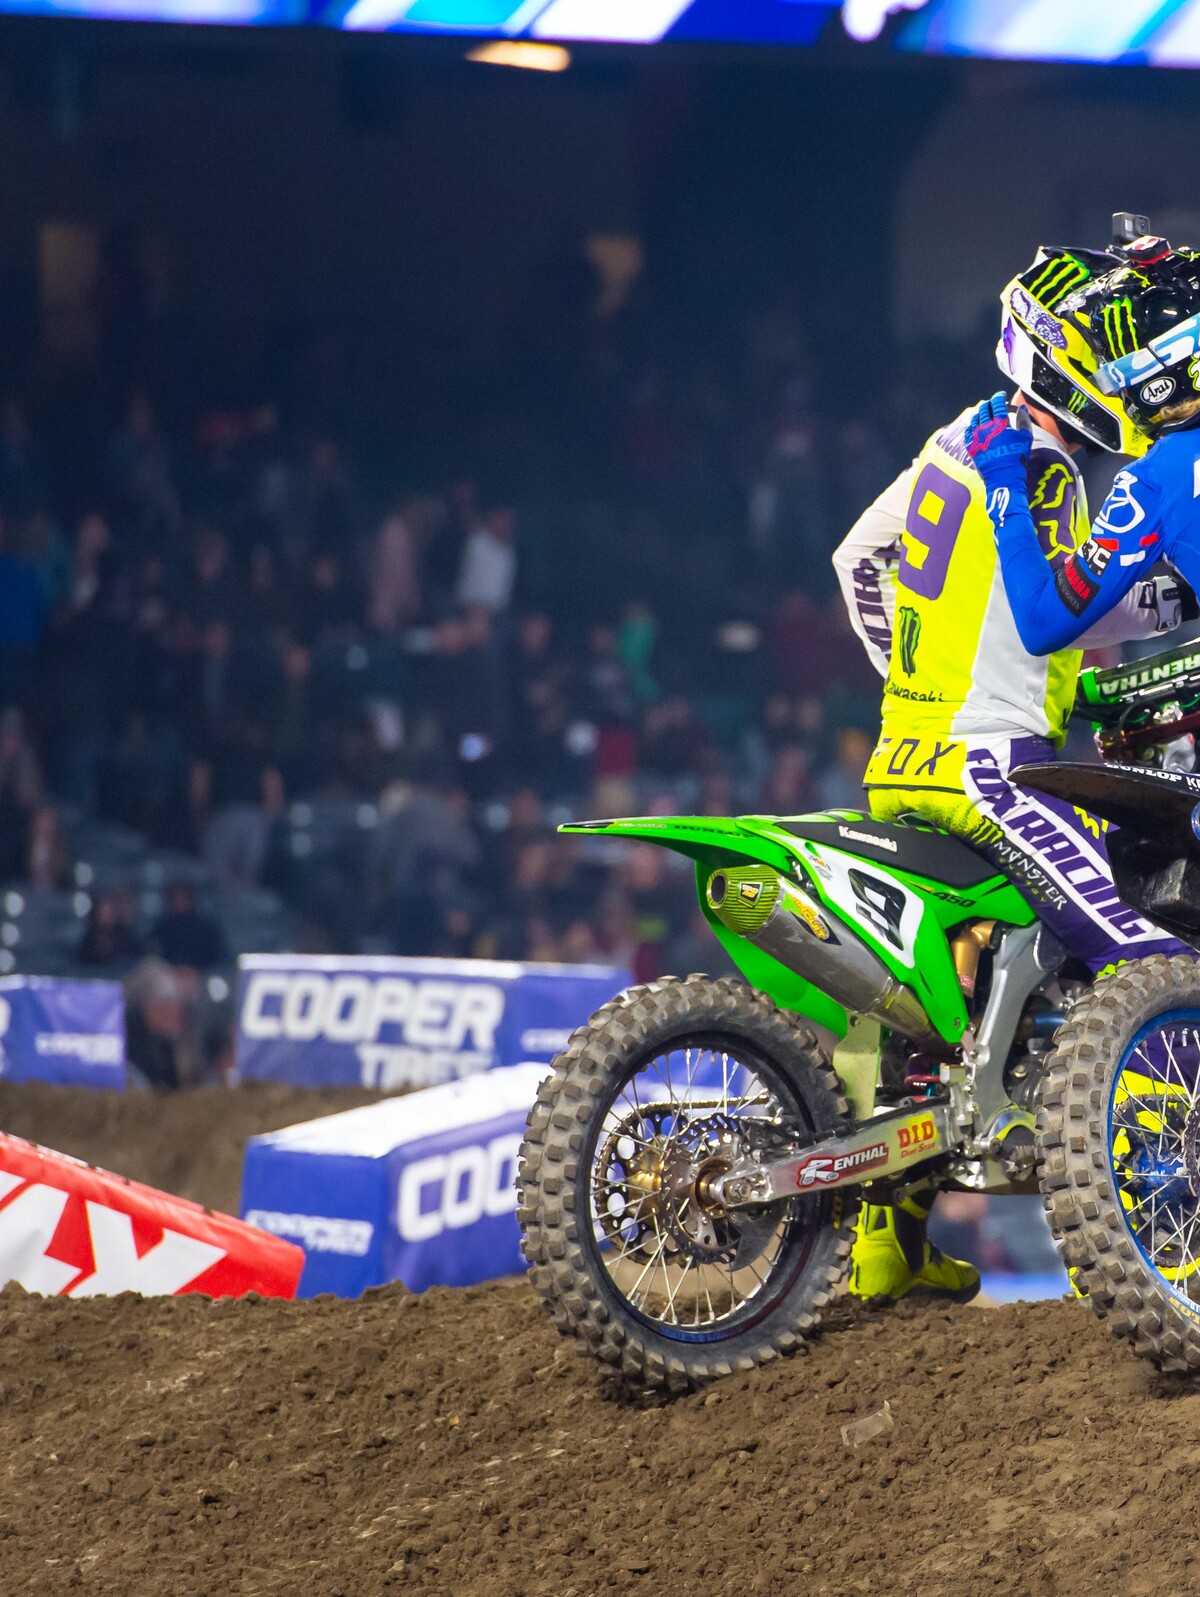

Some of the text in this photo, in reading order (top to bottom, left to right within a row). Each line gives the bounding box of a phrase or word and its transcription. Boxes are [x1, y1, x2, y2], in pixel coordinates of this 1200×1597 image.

[1144, 381, 1172, 400] Arai
[898, 463, 972, 601] 9
[932, 891, 977, 908] 450
[993, 841, 1068, 911] MONSTER
[1004, 809, 1148, 939] RACING
[242, 973, 504, 1050] COOPER
[800, 1145, 888, 1186] RENTHAL
[0, 1170, 228, 1297] LY
